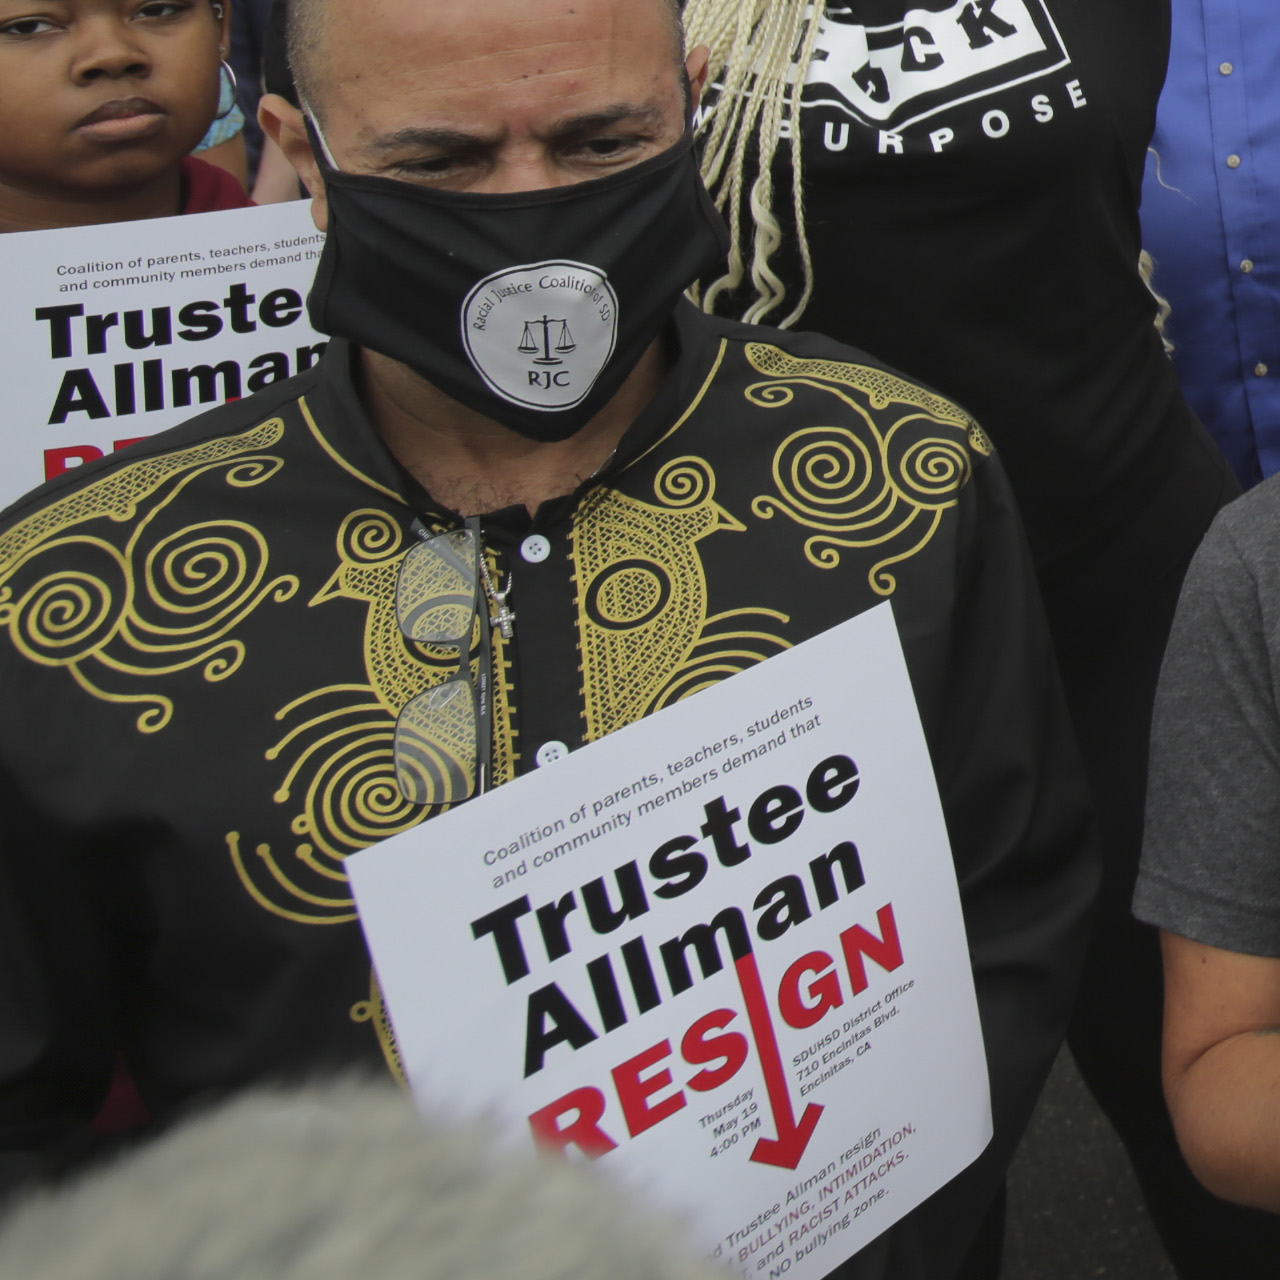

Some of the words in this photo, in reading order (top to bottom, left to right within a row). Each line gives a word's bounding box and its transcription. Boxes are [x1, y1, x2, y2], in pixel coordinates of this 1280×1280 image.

[57, 260, 124, 276] Coalition
[128, 257, 142, 269] of
[147, 251, 205, 268] parents,
[209, 242, 271, 259] teachers,
[274, 232, 326, 250] students
[59, 278, 88, 293] and
[93, 271, 176, 290] community
[180, 263, 246, 280] members
[249, 251, 302, 269] demand
[305, 249, 323, 262] tha
[35, 282, 303, 359] Truste
[473, 297, 495, 331] Racial
[491, 282, 532, 303] Justice
[528, 370, 570, 390] RJC
[483, 819, 565, 866] Coalition
[569, 805, 589, 825] of
[593, 771, 664, 816] parents,
[666, 734, 744, 777] teachers,
[746, 695, 814, 738] students
[493, 864, 528, 889] and
[532, 808, 632, 868] community
[637, 767, 719, 817] members
[721, 734, 787, 773] demand
[789, 714, 822, 738] that
[470, 754, 861, 987] Trustee
[523, 840, 866, 1080] Allman
[528, 901, 904, 1163] RESIGN
[792, 1029, 840, 1067] SDUHSD
[843, 1001, 882, 1034] District
[884, 979, 915, 1003] Office
[796, 1061, 819, 1081] 710
[822, 1027, 872, 1064] Encinitas
[873, 1007, 900, 1028] Blvd.
[699, 1088, 754, 1129] Thursday
[800, 1058, 854, 1098] Encinitas,
[856, 1041, 872, 1056] CA
[710, 1133, 739, 1158] 4:00
[741, 1117, 762, 1138] PM
[713, 1117, 739, 1139] May
[741, 1102, 758, 1119] 19
[725, 1202, 781, 1249] Trustee
[785, 1161, 836, 1204] Allman
[839, 1127, 881, 1162] resign
[738, 1201, 815, 1264] BULLYING,
[818, 1122, 917, 1204] INTIMIDATION,
[756, 1240, 785, 1271] and
[788, 1199, 841, 1247] RACIST
[844, 1150, 910, 1205] ATTACKS.
[769, 1258, 791, 1280] NO
[795, 1213, 851, 1261] bullying
[853, 1188, 890, 1219] zone.
